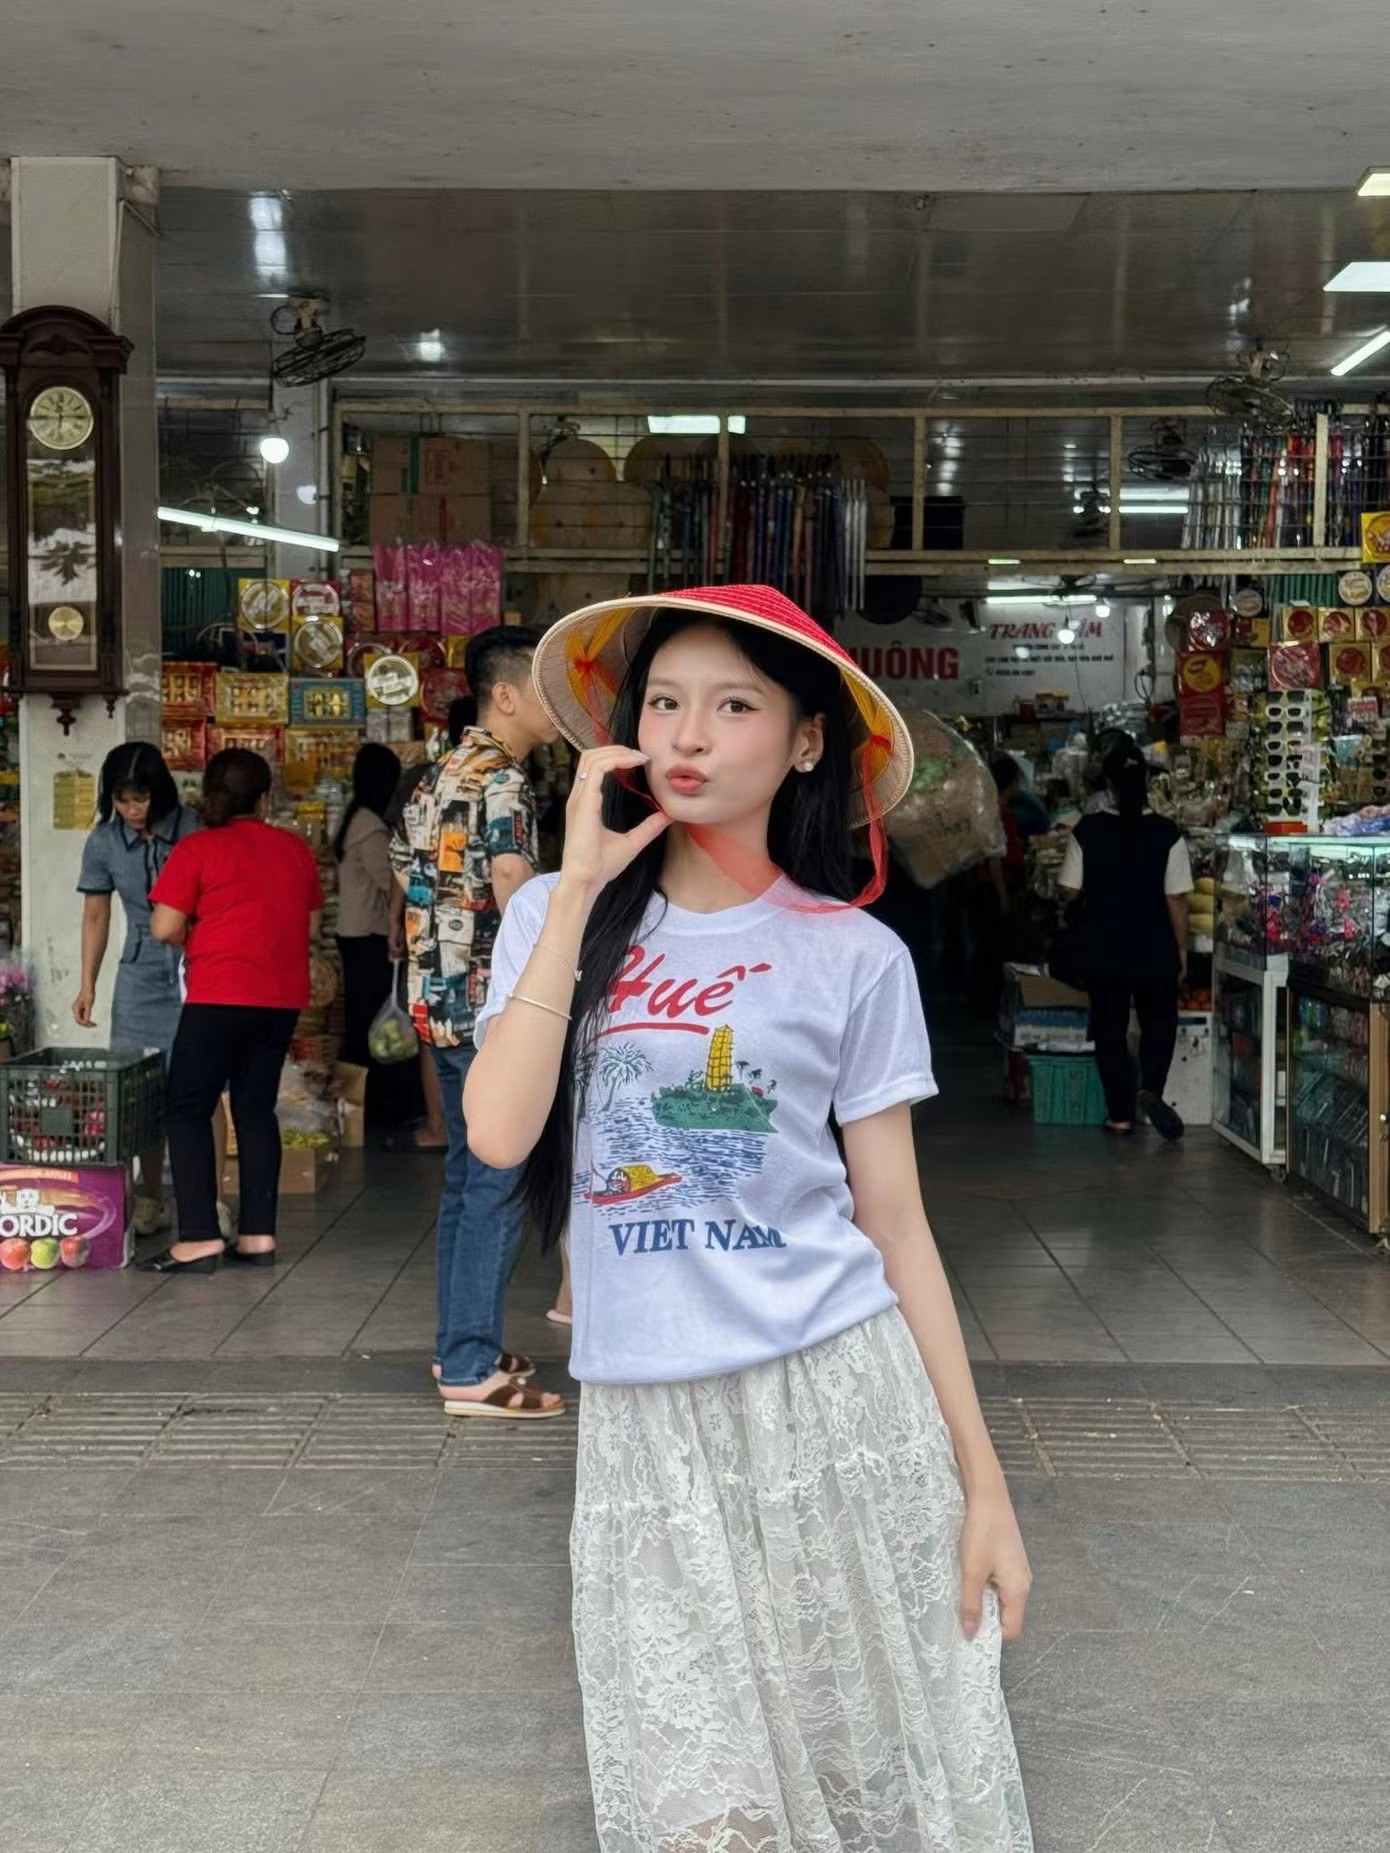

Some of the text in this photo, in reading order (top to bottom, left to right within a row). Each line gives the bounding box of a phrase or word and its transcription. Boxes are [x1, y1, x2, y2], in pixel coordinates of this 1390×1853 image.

[990, 622, 1056, 639] TRANG
[606, 944, 772, 1018] Huế
[608, 1219, 787, 1256] VIET NAM
